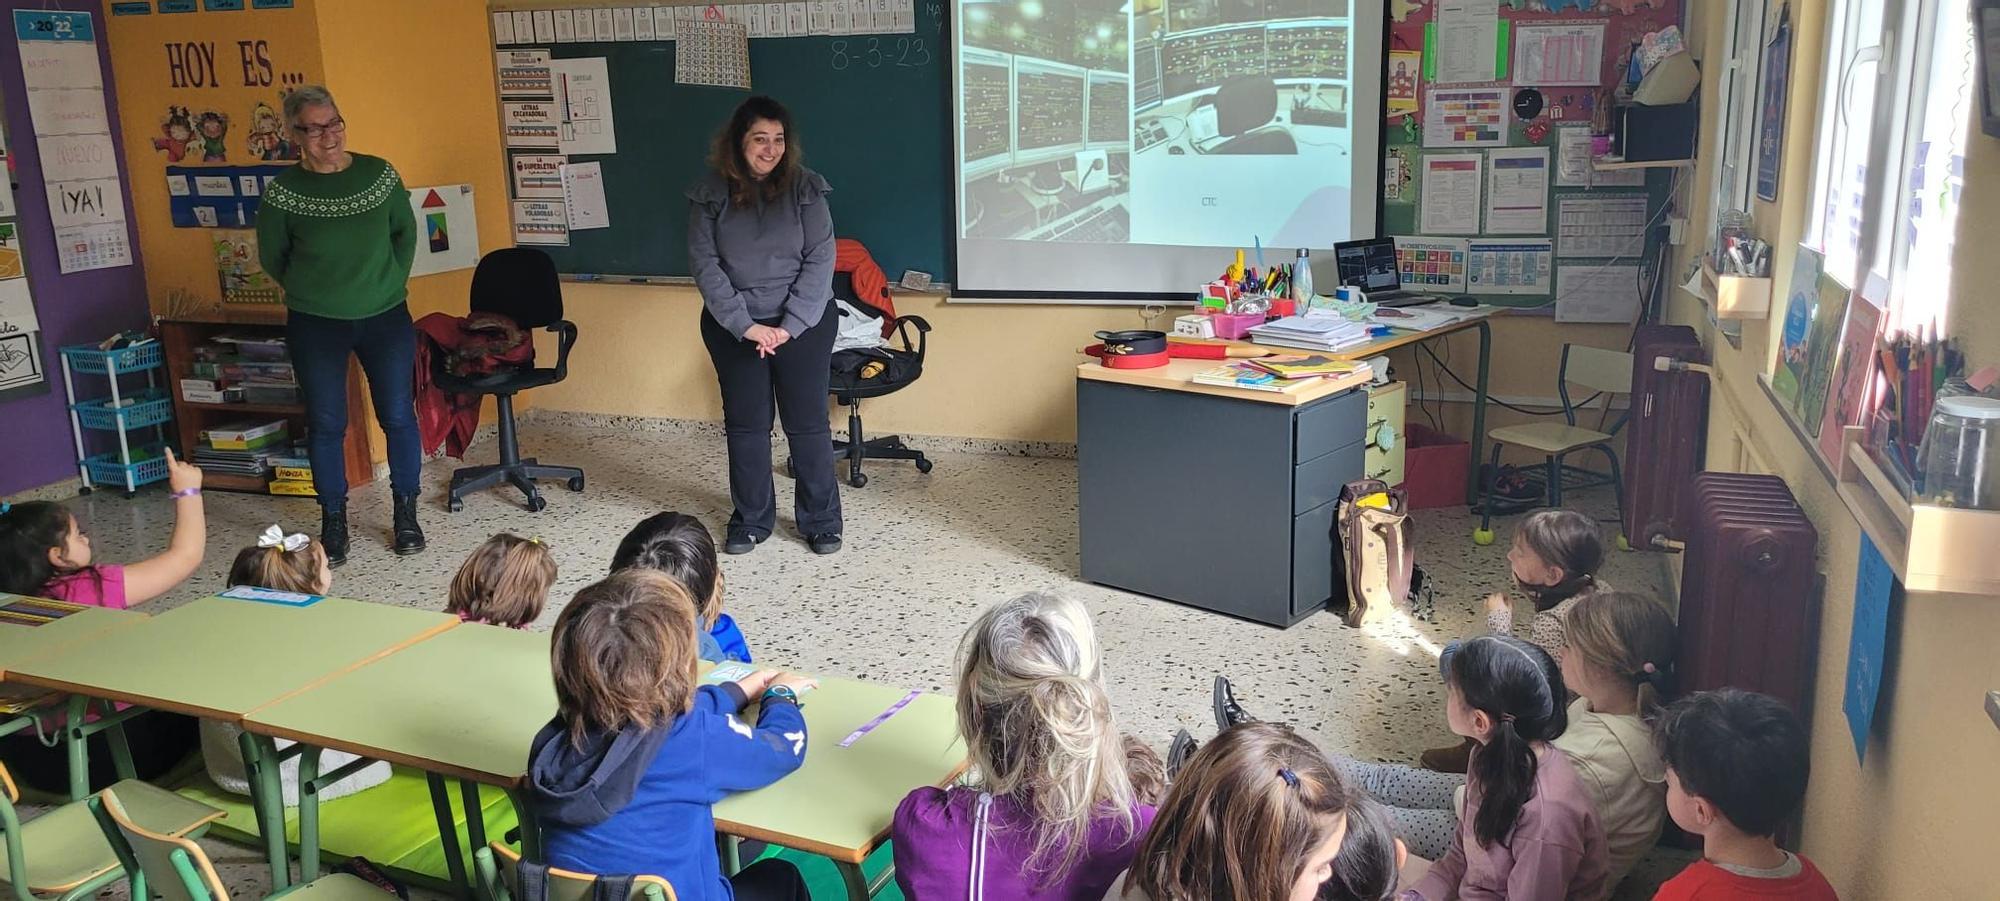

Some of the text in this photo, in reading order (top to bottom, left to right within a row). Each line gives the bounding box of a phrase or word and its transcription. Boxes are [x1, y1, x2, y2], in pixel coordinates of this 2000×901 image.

[37, 20, 71, 33] 2022
[831, 37, 931, 70] 8-3-23
[165, 41, 219, 88] HOY
[524, 162, 557, 170] SUPERLETRA
[244, 179, 253, 193] 7
[60, 184, 105, 217] ¡YA!
[1202, 197, 1217, 206] CTC
[199, 210, 209, 222] 2
